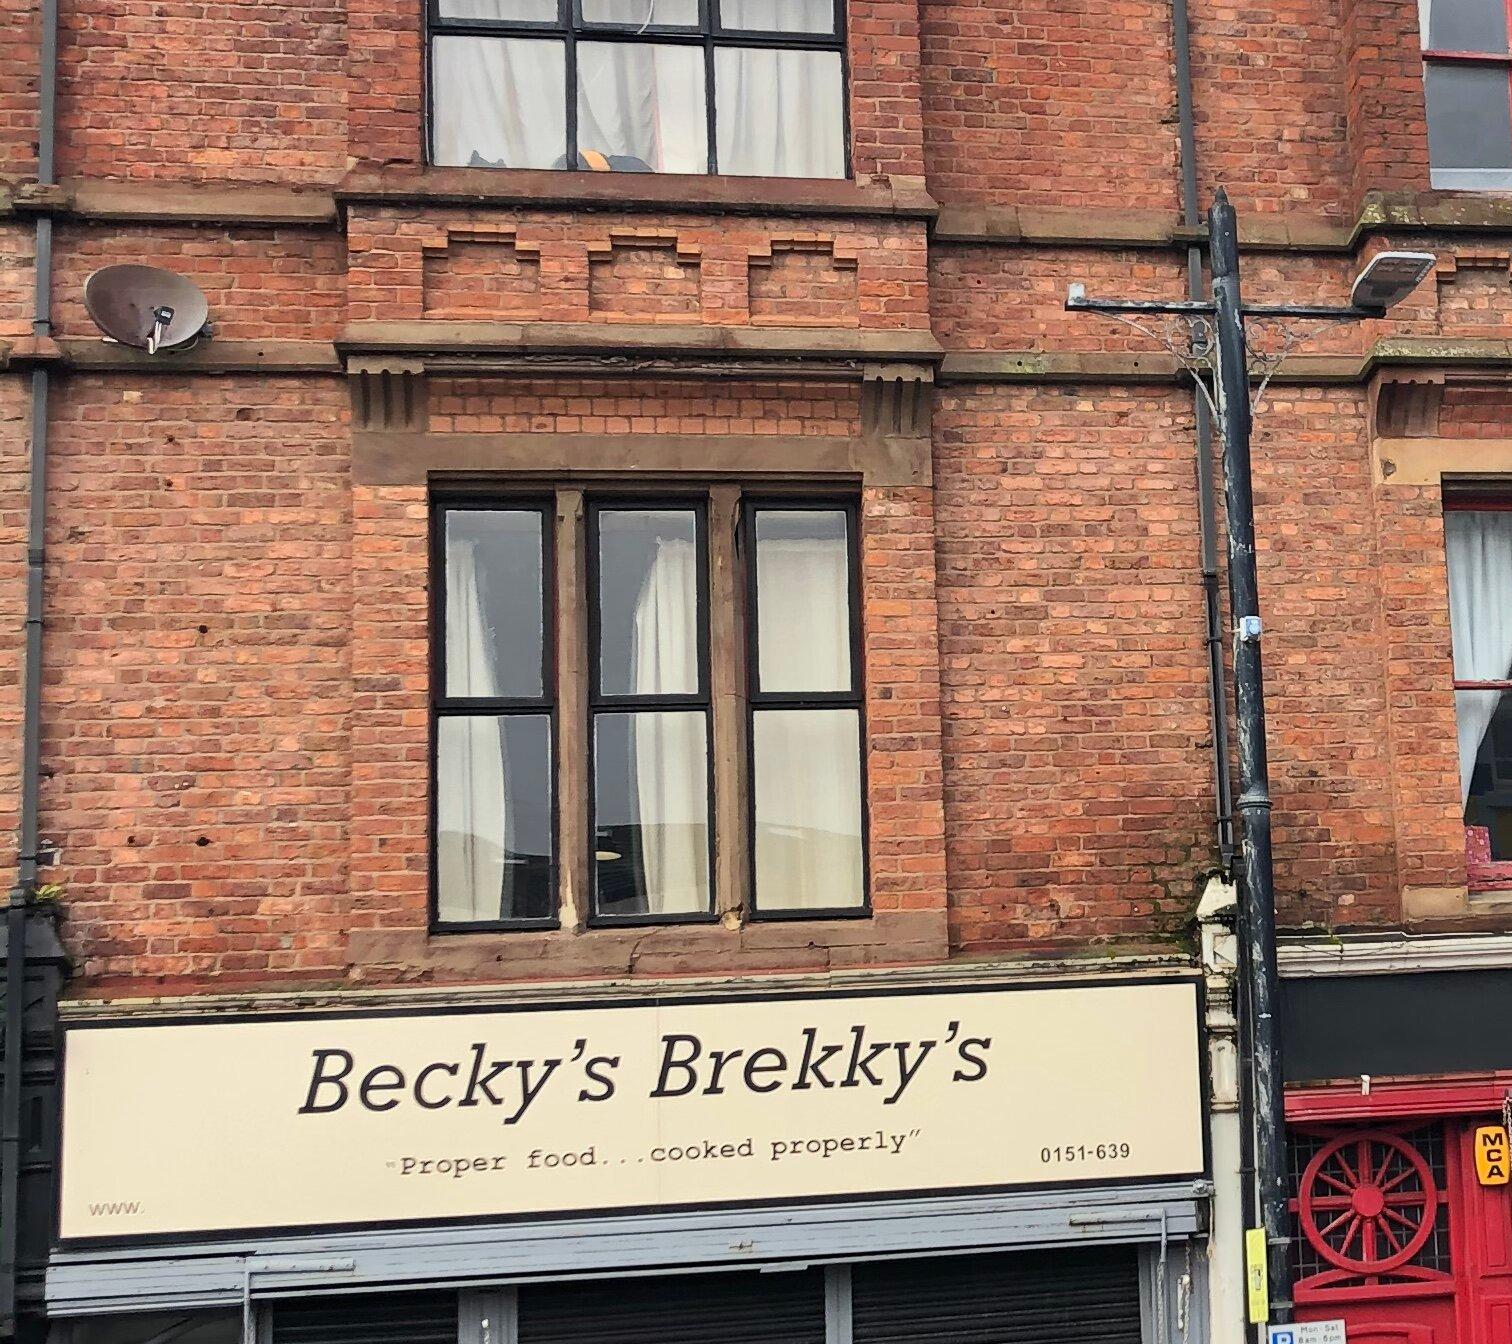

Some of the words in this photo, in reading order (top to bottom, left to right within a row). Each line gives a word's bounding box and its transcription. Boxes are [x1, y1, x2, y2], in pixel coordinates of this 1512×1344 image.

[297, 1038, 621, 1125] Becky’s
[649, 1020, 992, 1105] Brekky’s
[1040, 1142, 1130, 1163] 0151-639
[1481, 1132, 1505, 1179] MCA
